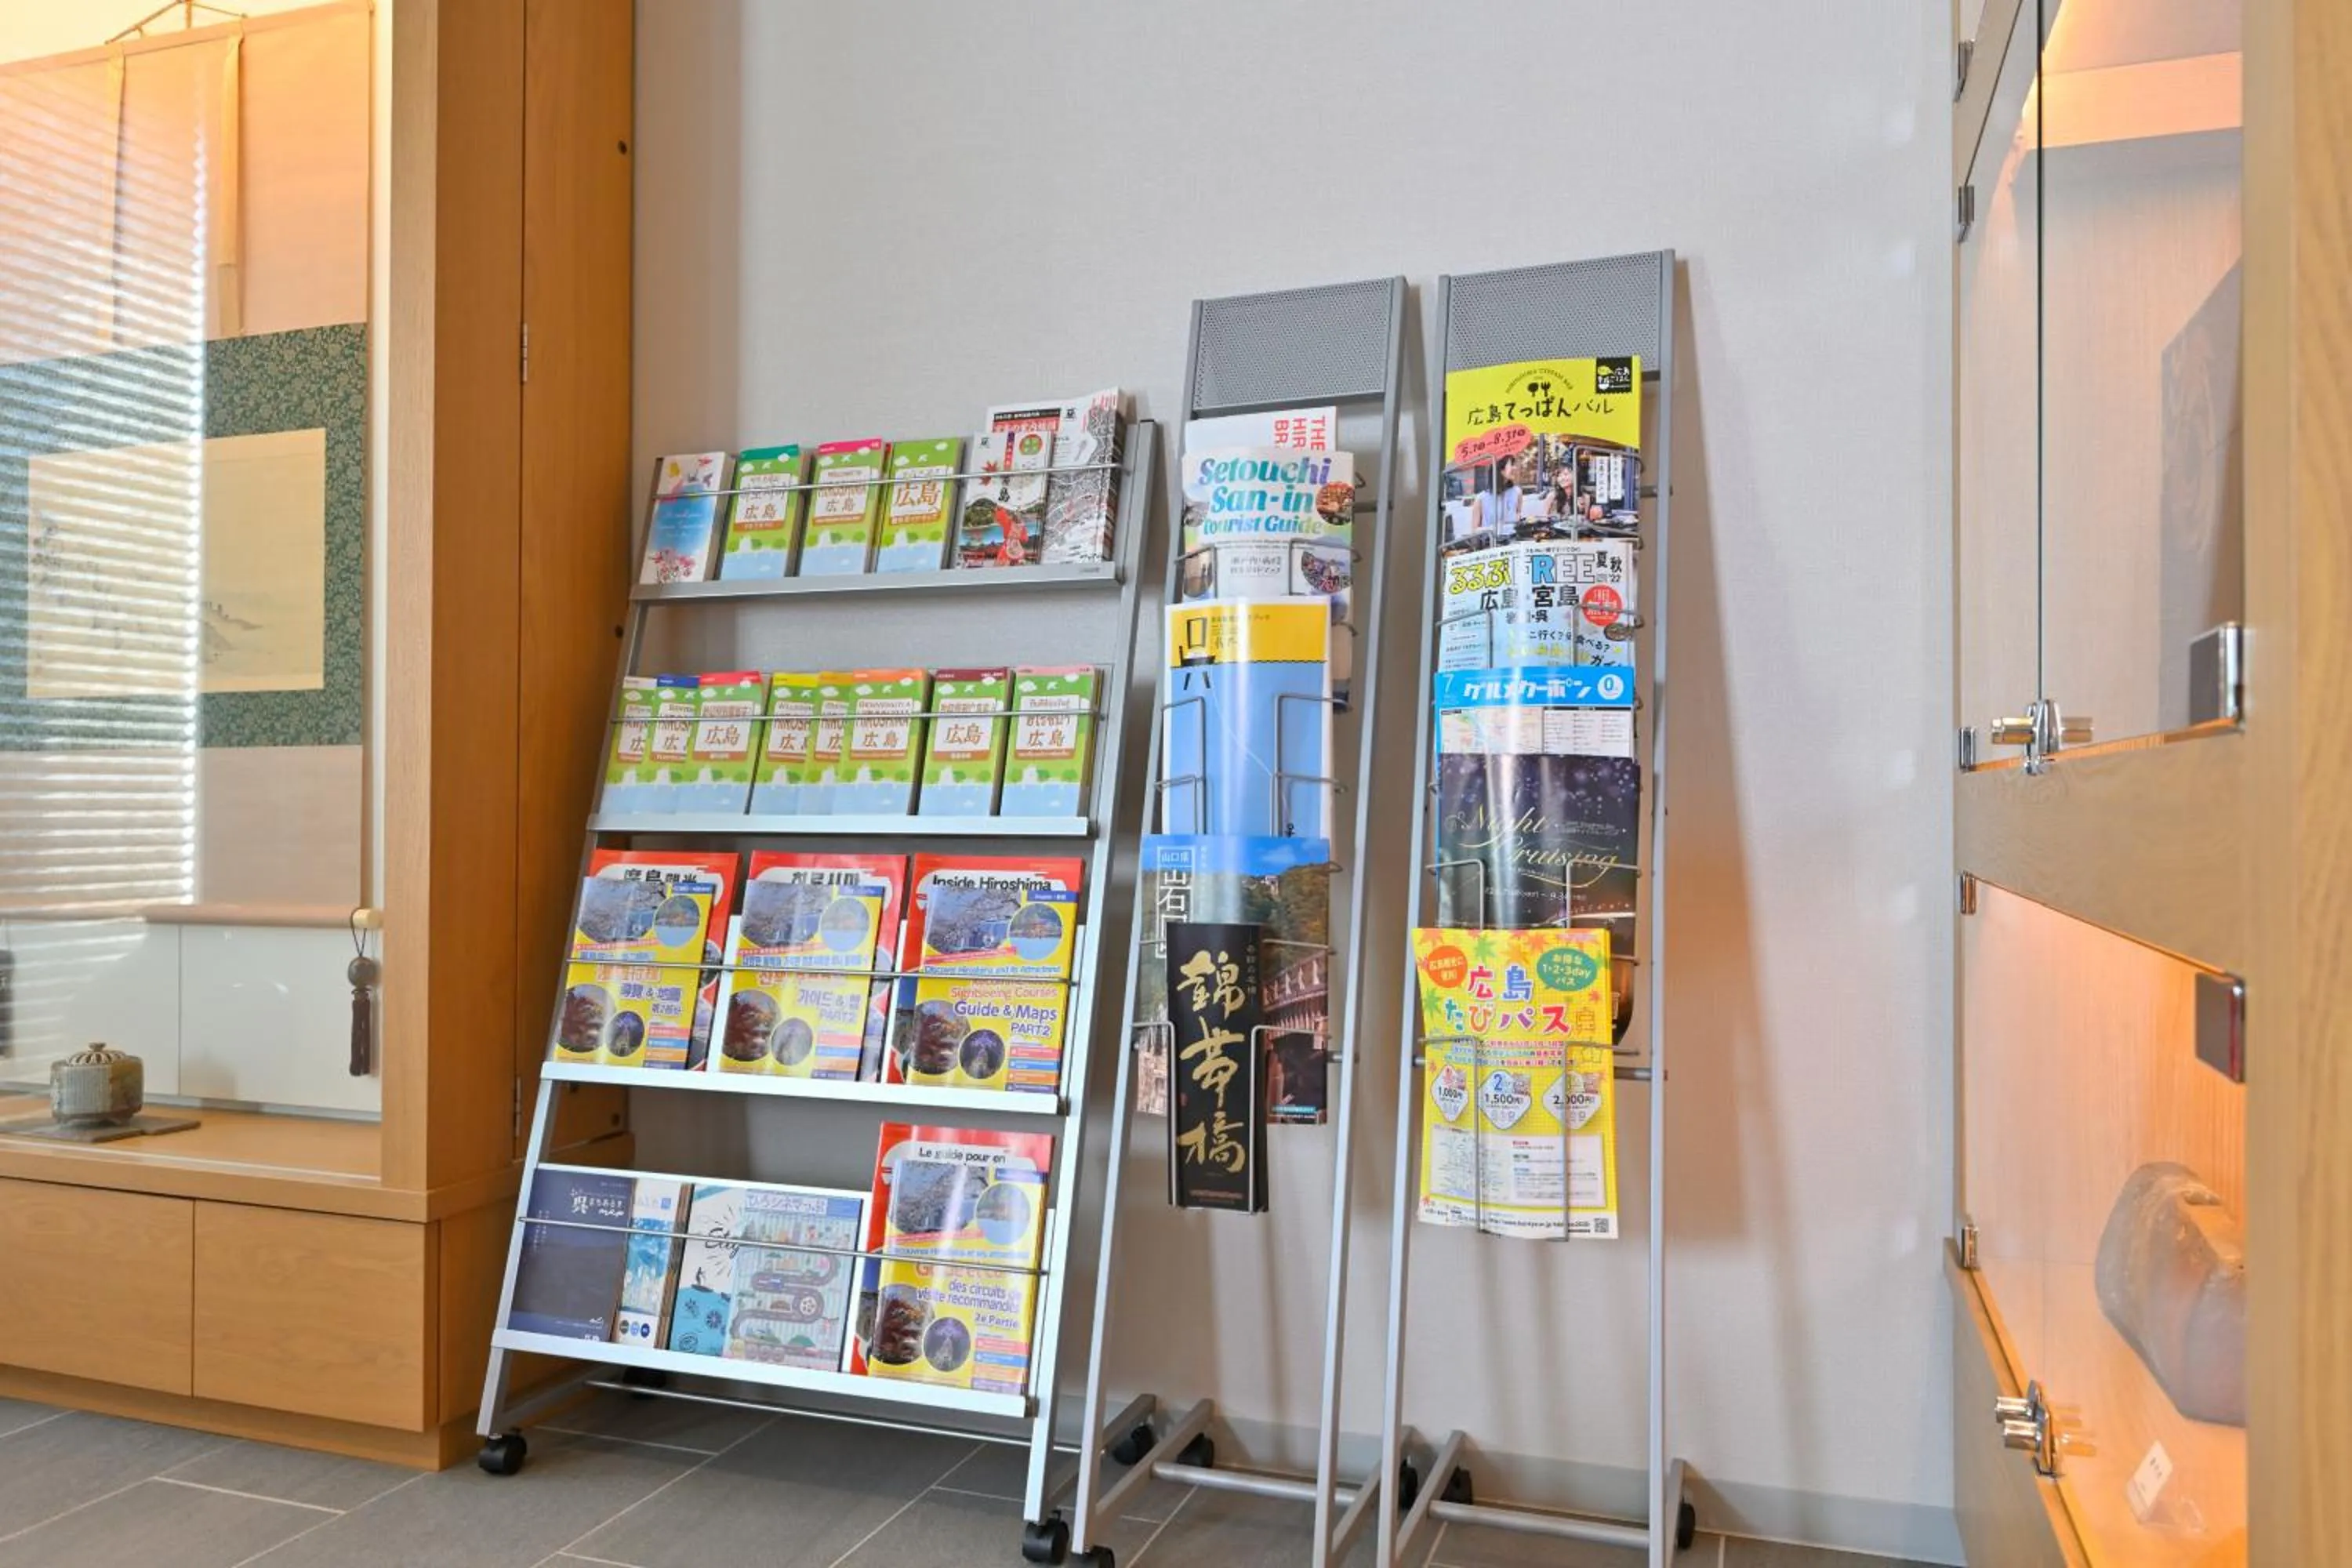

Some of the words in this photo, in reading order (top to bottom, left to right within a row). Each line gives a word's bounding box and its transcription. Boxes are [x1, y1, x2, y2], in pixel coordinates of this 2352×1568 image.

[1467, 393, 1614, 426] 広島てっぱんバル
[1310, 415, 1326, 451] THE
[1198, 457, 1332, 485] Setouchi
[896, 479, 942, 507] 広島
[1210, 485, 1314, 514] San-in
[1264, 514, 1321, 534] Guide
[1450, 557, 1513, 595] るるぶ
[1463, 677, 1593, 700] グルメクーポン
[932, 874, 975, 888] Inside
[979, 876, 1052, 891] Hiroshima
[1468, 964, 1533, 1001] 広島
[798, 988, 833, 1008] 가이드
[953, 1000, 1000, 1017] Guide
[1003, 1007, 1012, 1016] &
[1015, 1004, 1058, 1024] Maps
[1444, 999, 1572, 1035] たびパス
[919, 1146, 932, 1158] Le
[935, 1149, 964, 1160] gide
[966, 1151, 989, 1165] pour
[993, 1154, 1006, 1164] en
[949, 1279, 967, 1293] des
[969, 1282, 1007, 1299] circuits
[988, 1314, 1019, 1328] Partie
